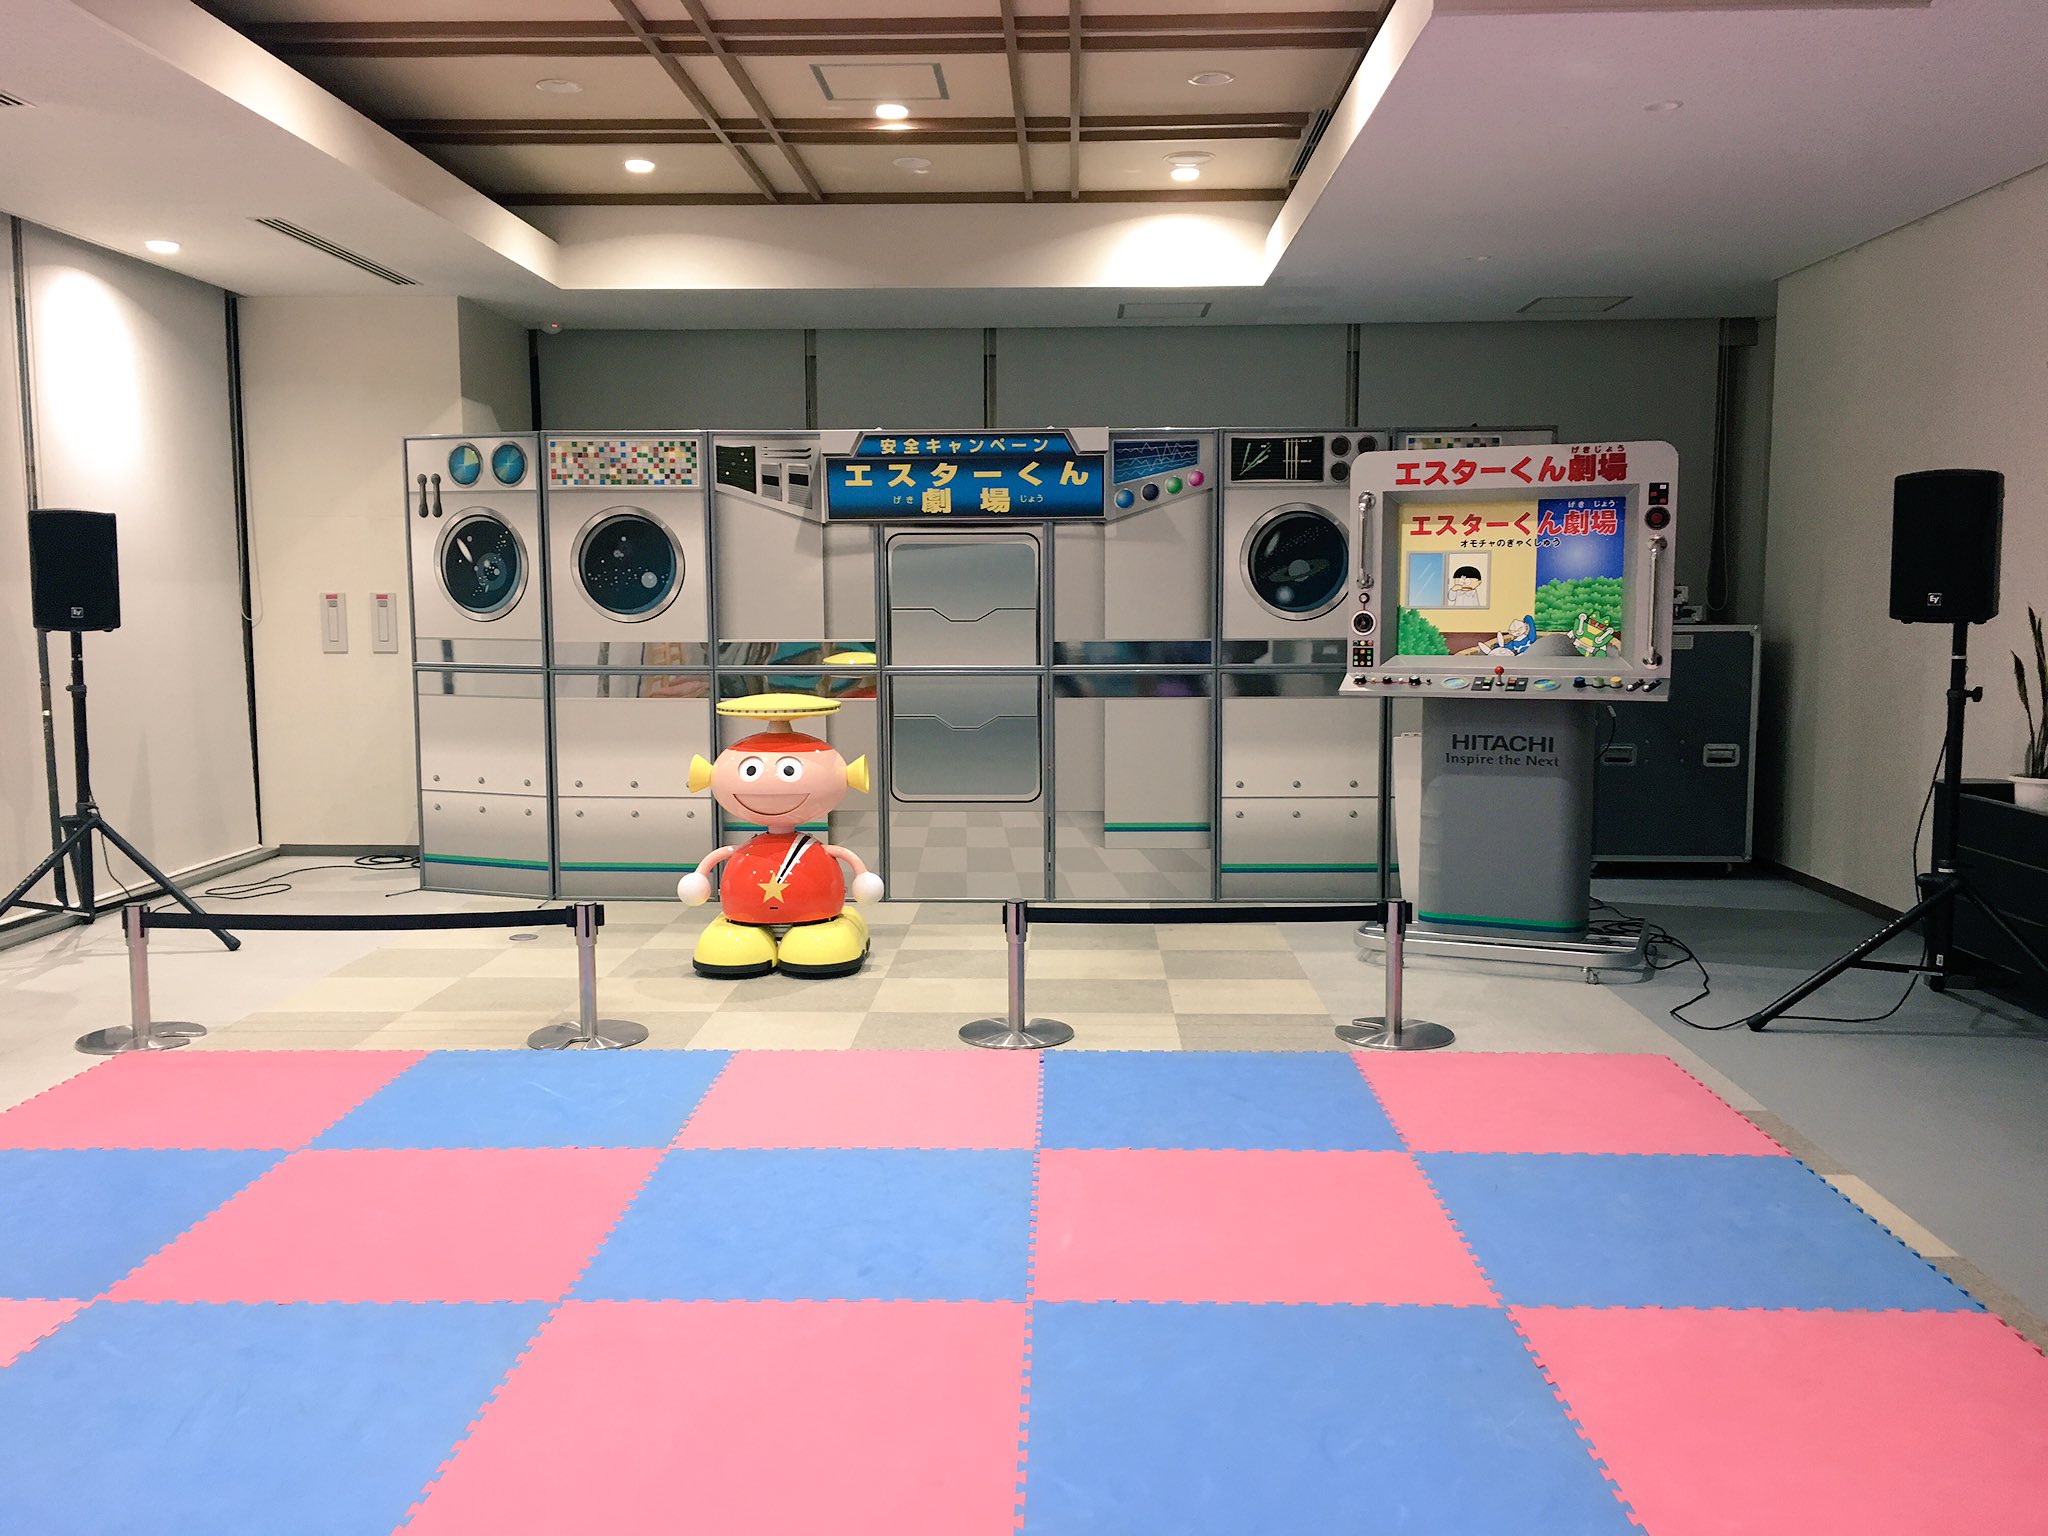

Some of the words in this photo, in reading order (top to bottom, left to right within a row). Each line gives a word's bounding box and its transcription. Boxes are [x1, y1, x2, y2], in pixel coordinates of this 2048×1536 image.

[880, 438, 1049, 455] 安全キャンペーン
[1571, 445, 1625, 453] げきじょう
[845, 460, 1089, 487] エスターくん
[1395, 453, 1628, 485] エスターくん劇場
[1019, 494, 1045, 503] じょう
[1410, 508, 1619, 537] エスターくん劇場
[1460, 538, 1561, 548] オモチャのぎゃくしゅう
[1452, 734, 1554, 752] HITACHI
[1445, 753, 1494, 766] Inspire
[1499, 754, 1521, 766] the
[1526, 755, 1560, 767] Next
